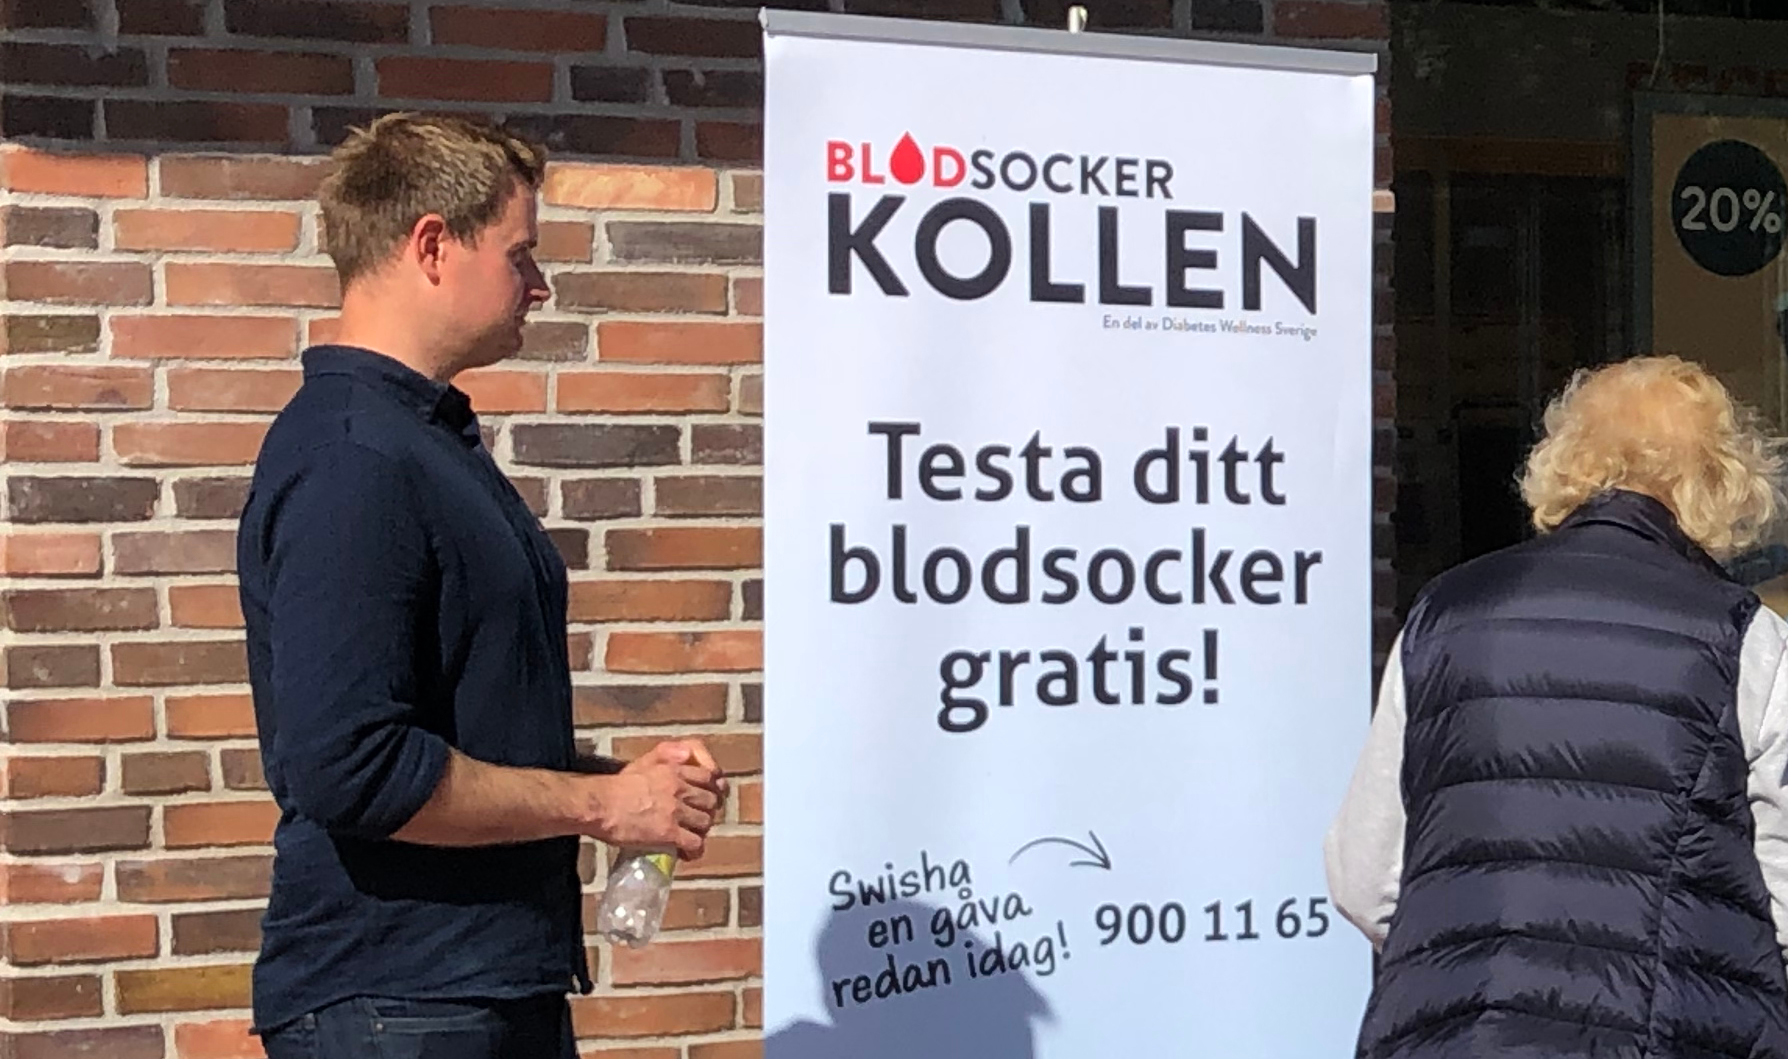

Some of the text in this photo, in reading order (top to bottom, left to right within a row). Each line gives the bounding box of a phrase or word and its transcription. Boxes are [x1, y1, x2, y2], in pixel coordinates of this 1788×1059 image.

[826, 130, 1174, 199] BLODSOCKER
[1679, 184, 1782, 234] 20%
[828, 192, 1318, 315] KOLLEN
[1102, 314, 1318, 341] En del av Diabetes Wellness Sverige
[868, 420, 1287, 506] Testa ditt
[829, 523, 1323, 606] blodsocker
[937, 628, 1221, 733] gratis!
[828, 850, 972, 913] Swisha
[867, 886, 1033, 950] en gåva
[1095, 895, 1331, 948] 900 11 65
[831, 922, 1070, 1010] redan idag!
